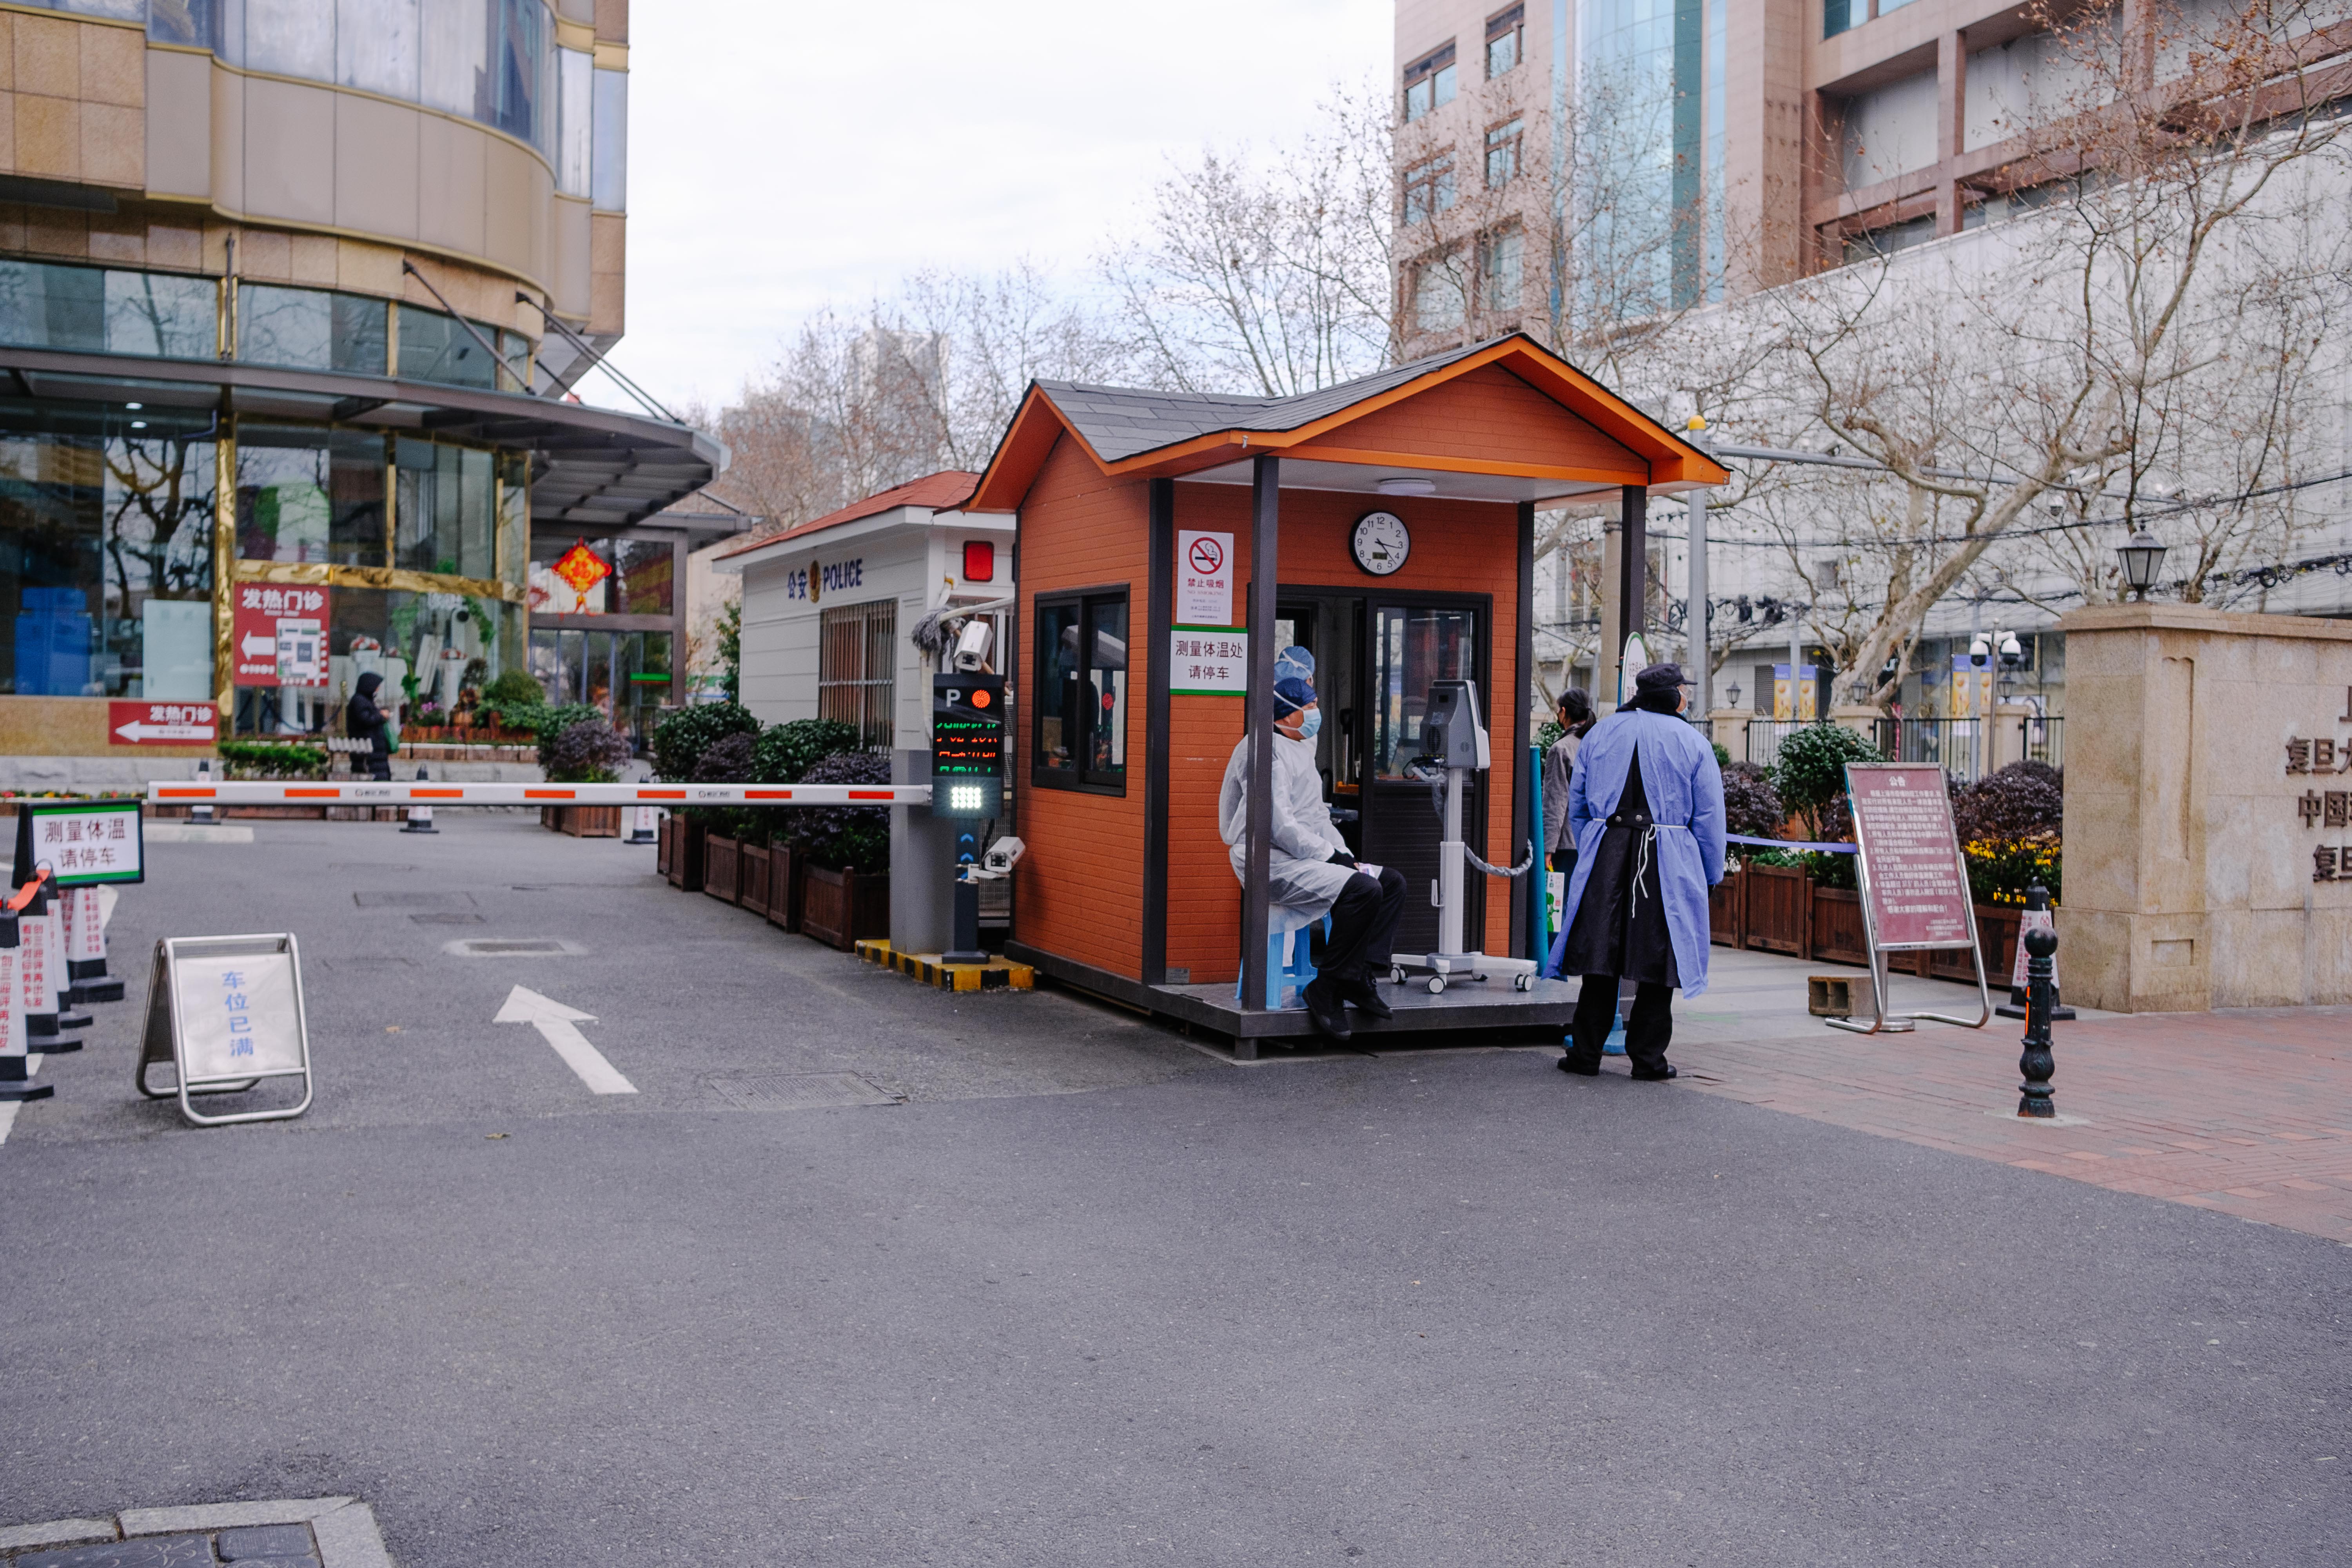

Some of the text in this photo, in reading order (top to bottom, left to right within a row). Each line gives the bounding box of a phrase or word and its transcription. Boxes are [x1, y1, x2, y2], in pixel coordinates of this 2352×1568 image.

[788, 568, 807, 600] 公安
[823, 558, 862, 592] POLICE
[1188, 578, 1224, 588] 禁止吸烟
[242, 588, 323, 611] 发热门诊
[1176, 640, 1242, 658] 测量体温处
[1189, 665, 1229, 680] 请停车
[946, 689, 961, 708] P
[150, 705, 212, 722] 发热门诊
[1889, 775, 1906, 787] 公告
[2298, 789, 2352, 829] 中国
[45, 817, 125, 843] 测量体温
[59, 845, 116, 869] 请停车
[221, 971, 253, 1057] 车位已满
